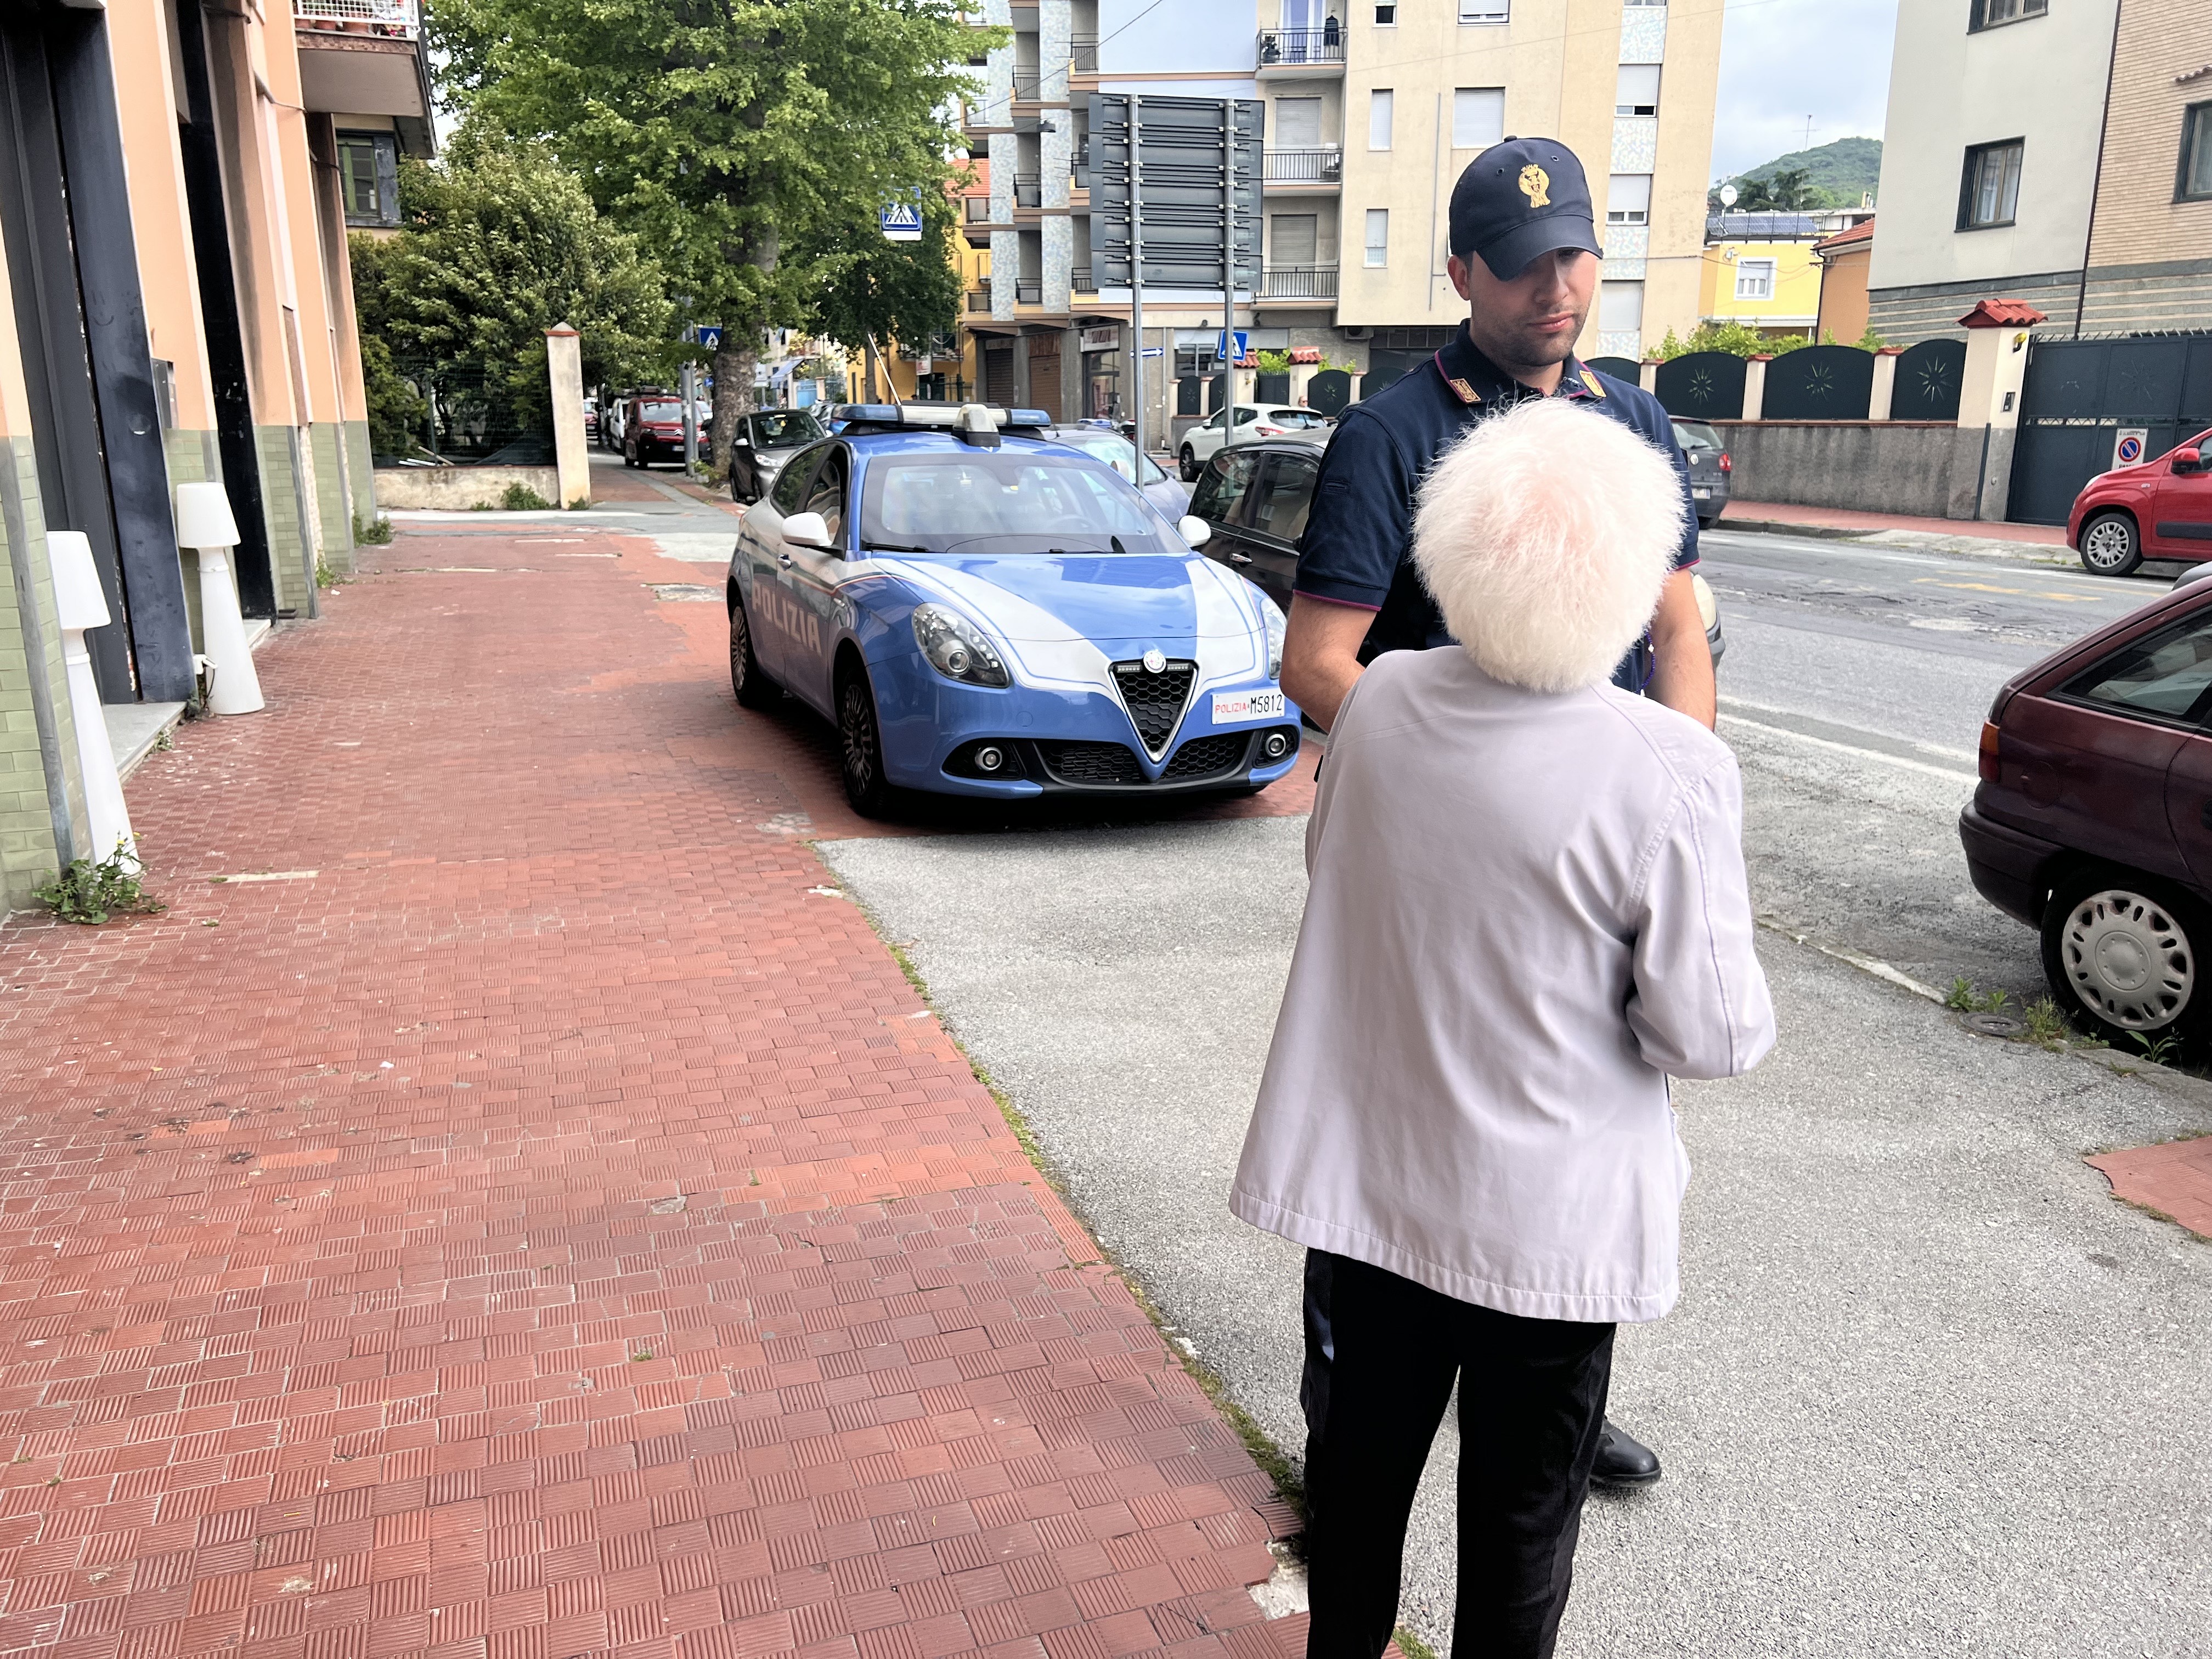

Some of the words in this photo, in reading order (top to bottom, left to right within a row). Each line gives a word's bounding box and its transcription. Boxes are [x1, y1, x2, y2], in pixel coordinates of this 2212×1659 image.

[752, 579, 822, 656] POLIZIA
[1215, 702, 1246, 714] POLIZIA
[1250, 694, 1282, 714] M5812
